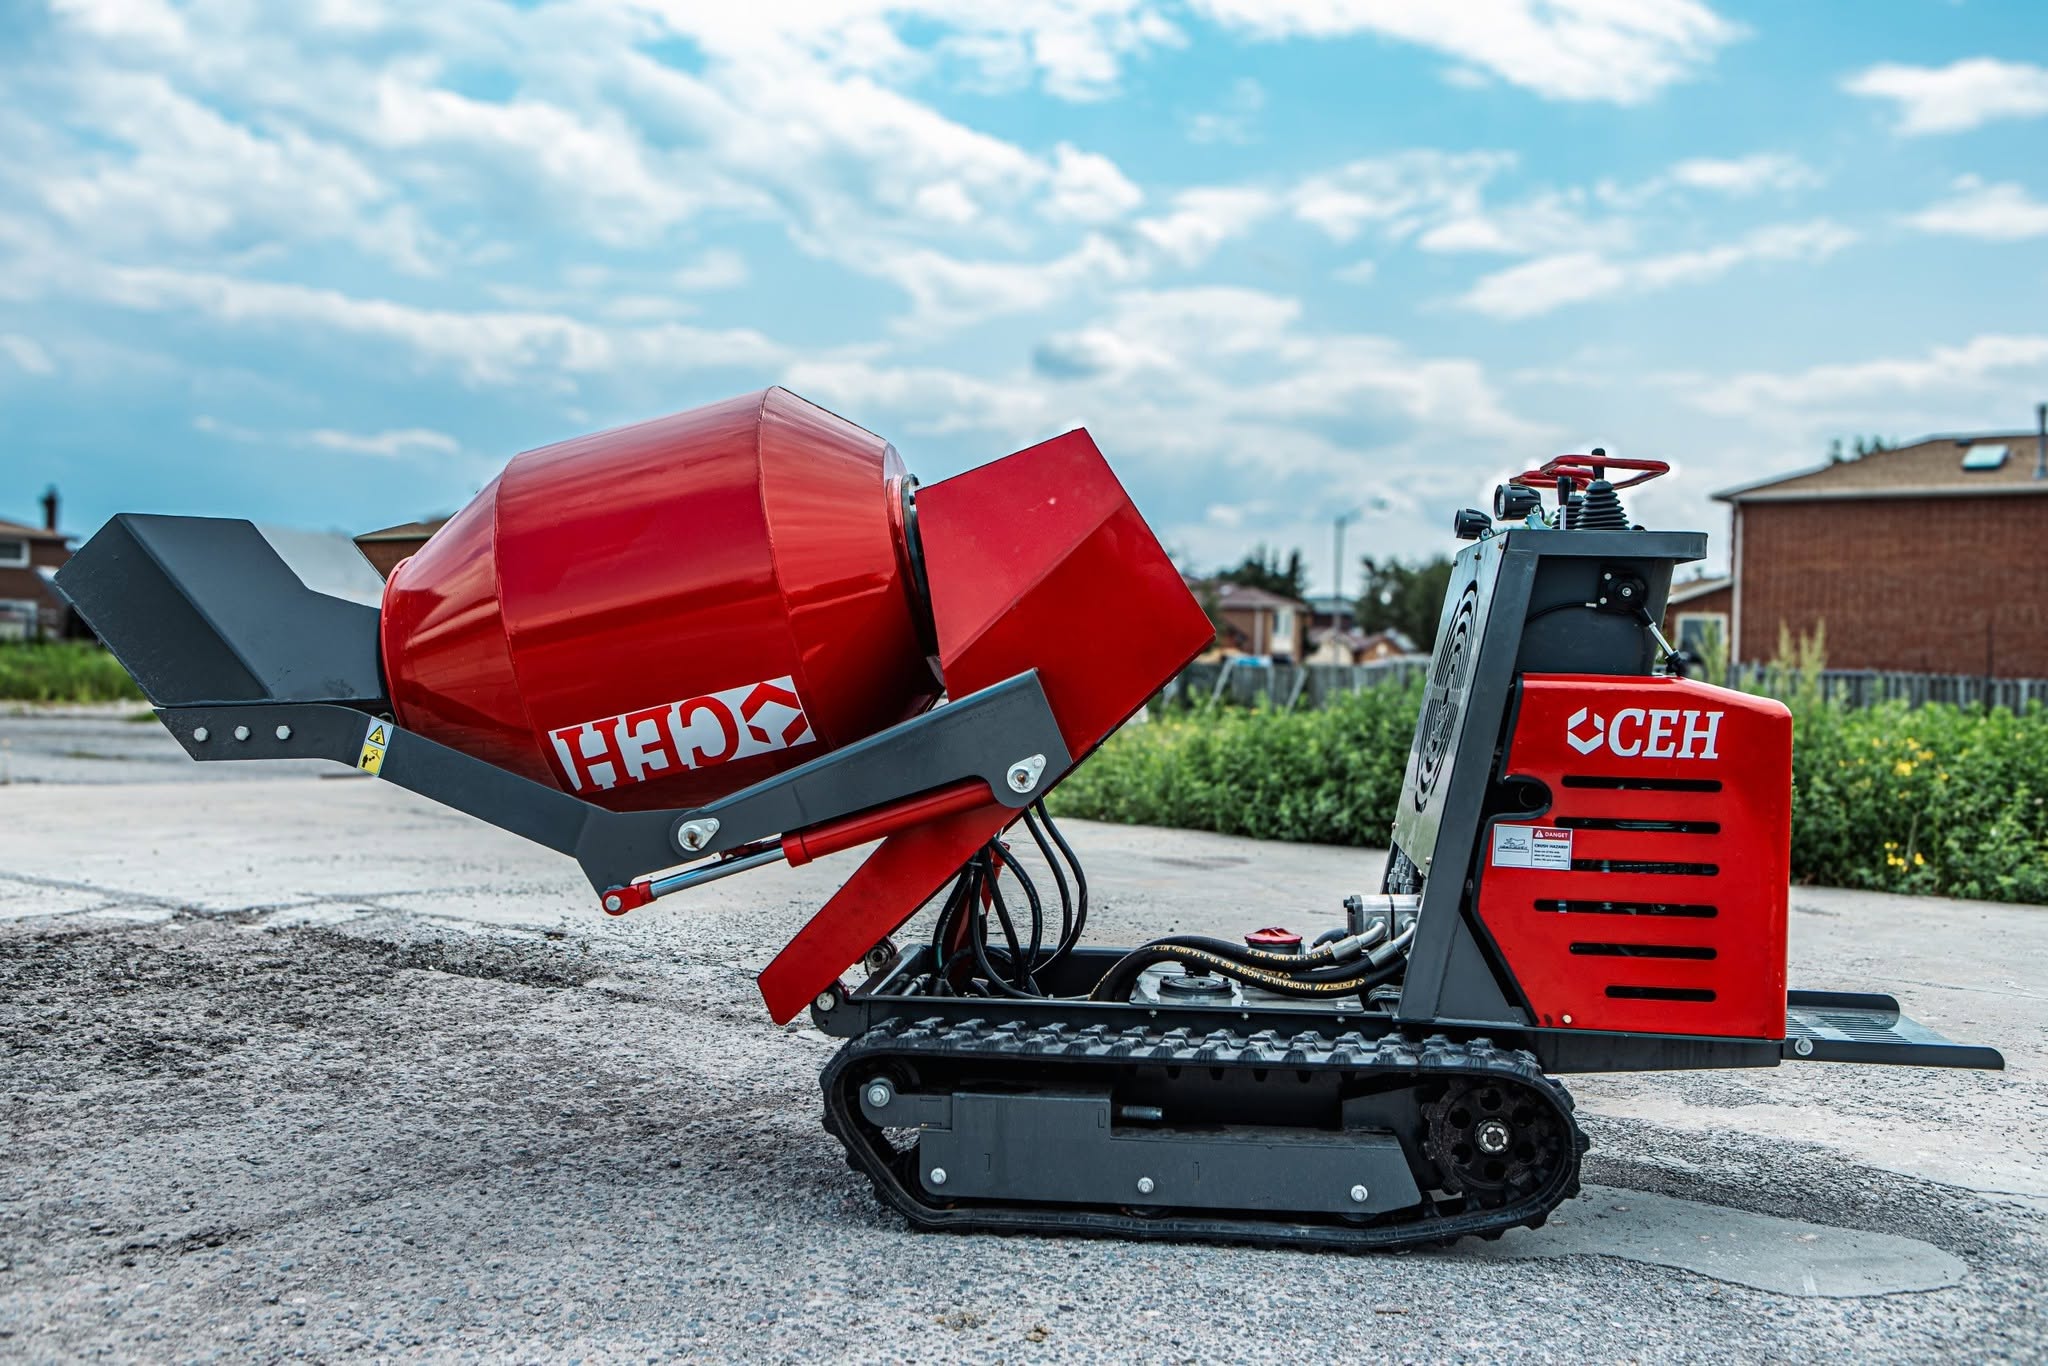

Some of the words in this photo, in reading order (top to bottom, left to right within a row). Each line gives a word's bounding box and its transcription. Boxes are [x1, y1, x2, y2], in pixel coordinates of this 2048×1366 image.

[556, 695, 739, 795] CEH
[1608, 708, 1724, 759] CEH
[1237, 966, 1261, 979] HOSE
[1262, 975, 1312, 991] HYDRAULIC
